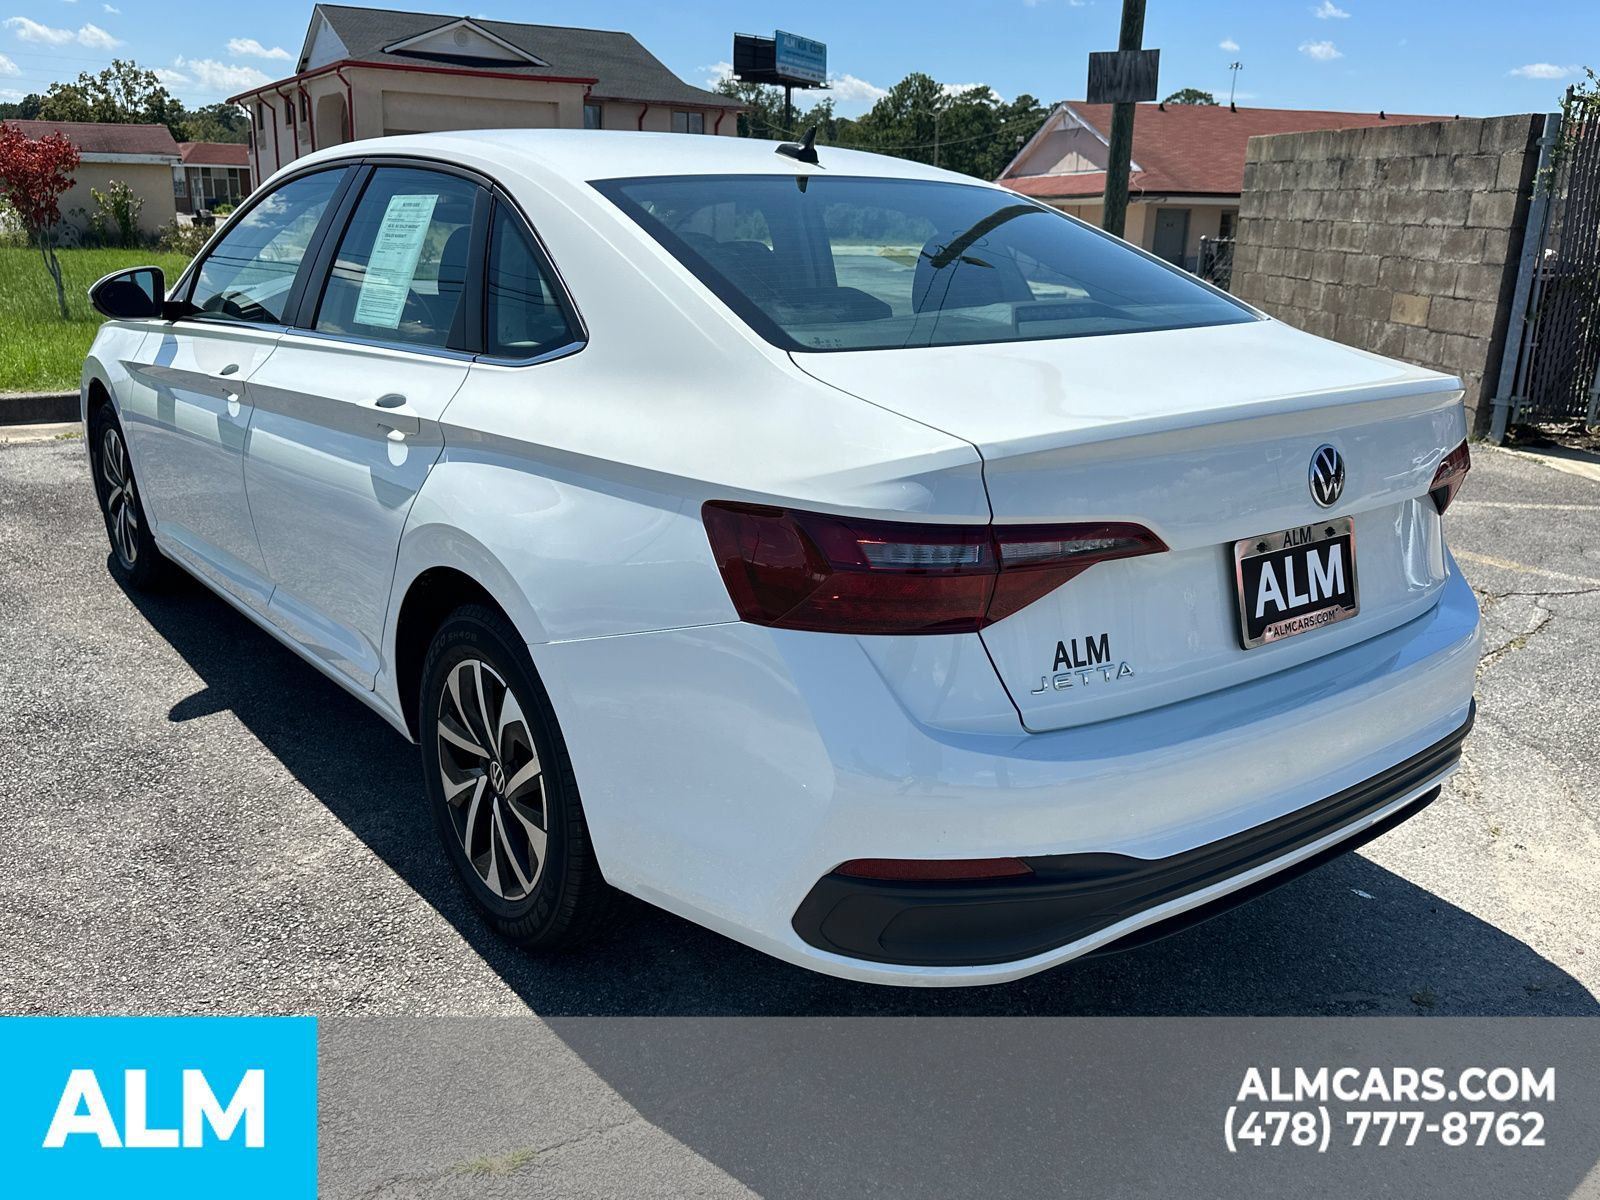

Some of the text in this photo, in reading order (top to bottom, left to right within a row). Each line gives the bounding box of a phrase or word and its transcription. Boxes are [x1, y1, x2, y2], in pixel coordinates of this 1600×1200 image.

[1282, 526, 1312, 548] ALM
[1255, 544, 1345, 618] ALM
[1273, 610, 1335, 638] ALMCARS.COM
[1052, 632, 1111, 672] ALM
[1030, 661, 1135, 695] JETTA
